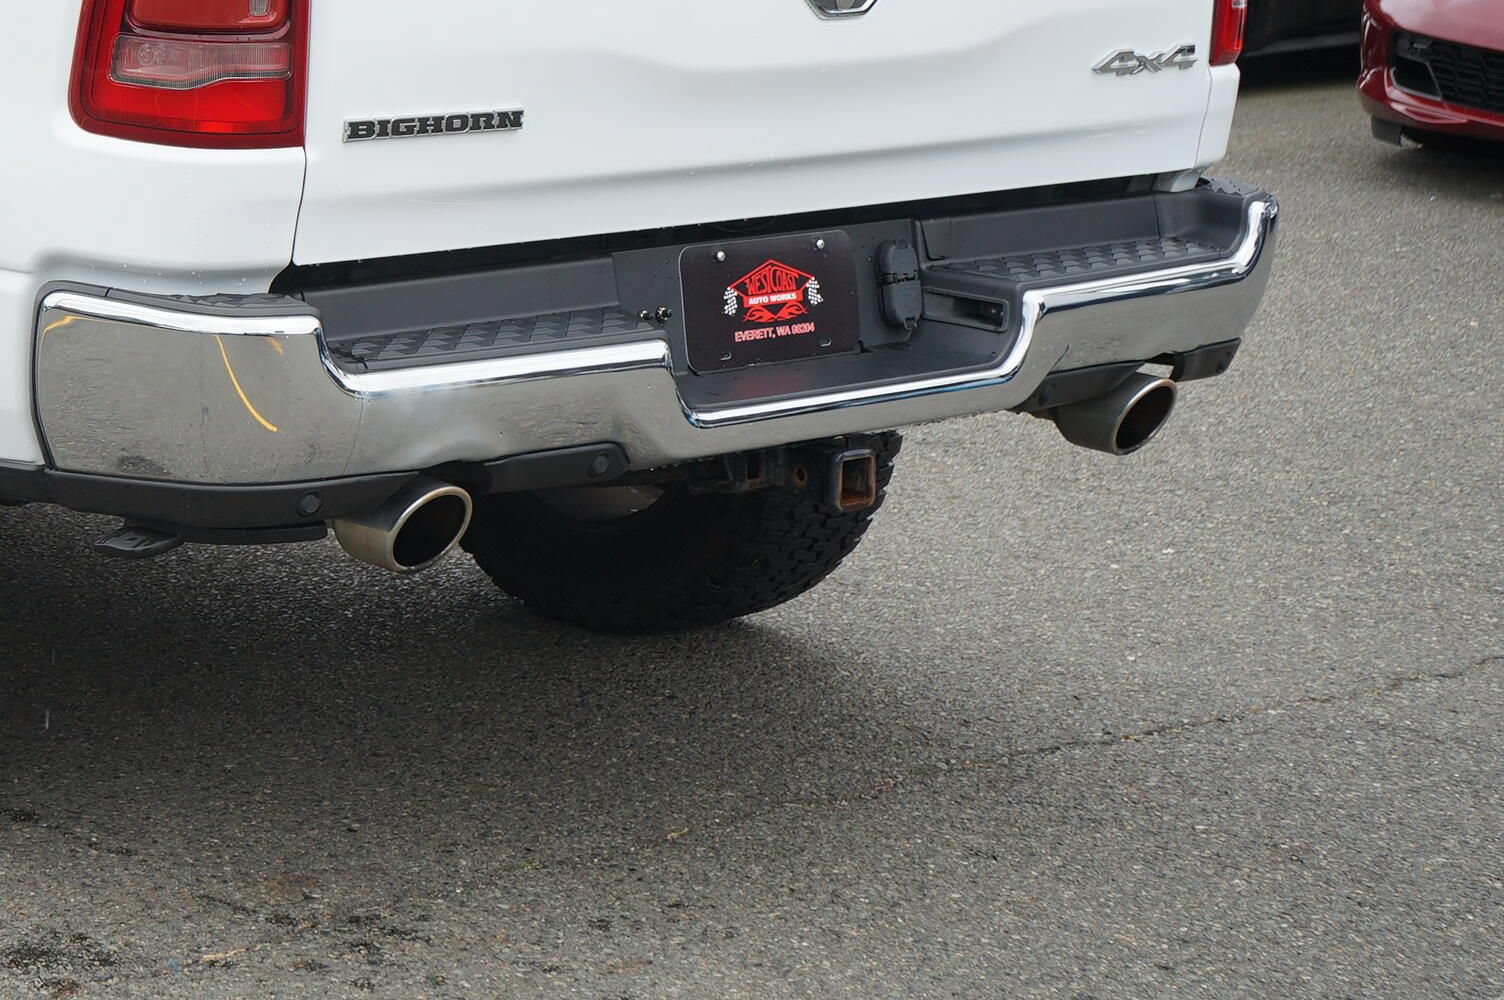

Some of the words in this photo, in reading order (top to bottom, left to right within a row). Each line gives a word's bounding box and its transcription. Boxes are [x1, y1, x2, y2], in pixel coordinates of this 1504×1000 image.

[343, 109, 525, 142] BIGHORN
[748, 295, 769, 305] AUTO
[769, 292, 797, 303] WORKS
[734, 327, 776, 342] EVERETT,
[776, 325, 791, 336] WA
